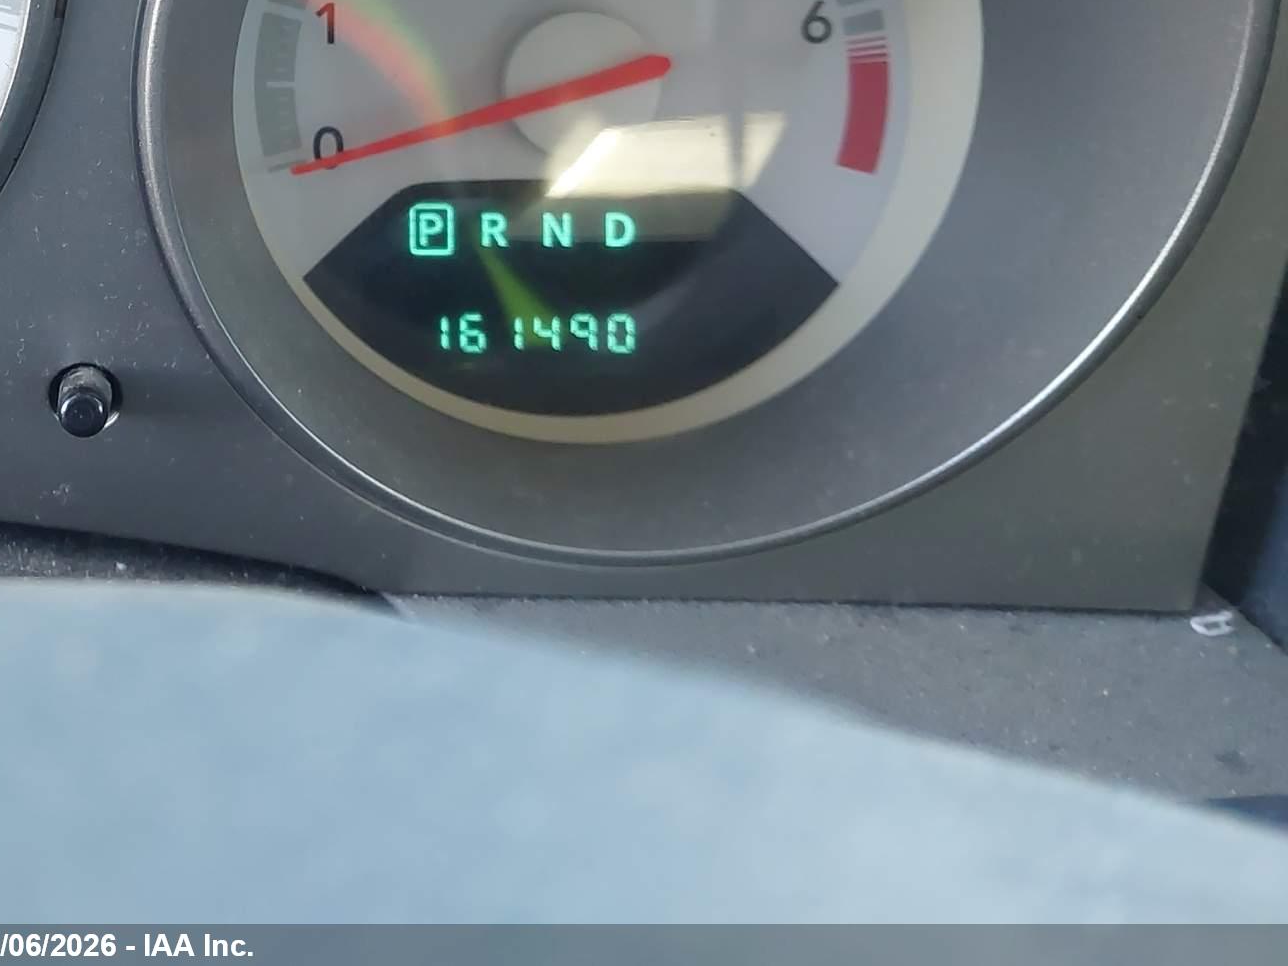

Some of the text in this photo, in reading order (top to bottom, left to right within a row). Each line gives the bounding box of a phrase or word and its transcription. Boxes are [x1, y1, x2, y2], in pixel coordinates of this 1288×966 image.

[314, 2, 338, 45] 1
[800, 0, 833, 44] 6
[313, 125, 345, 170] 0
[418, 211, 637, 248] P R N D
